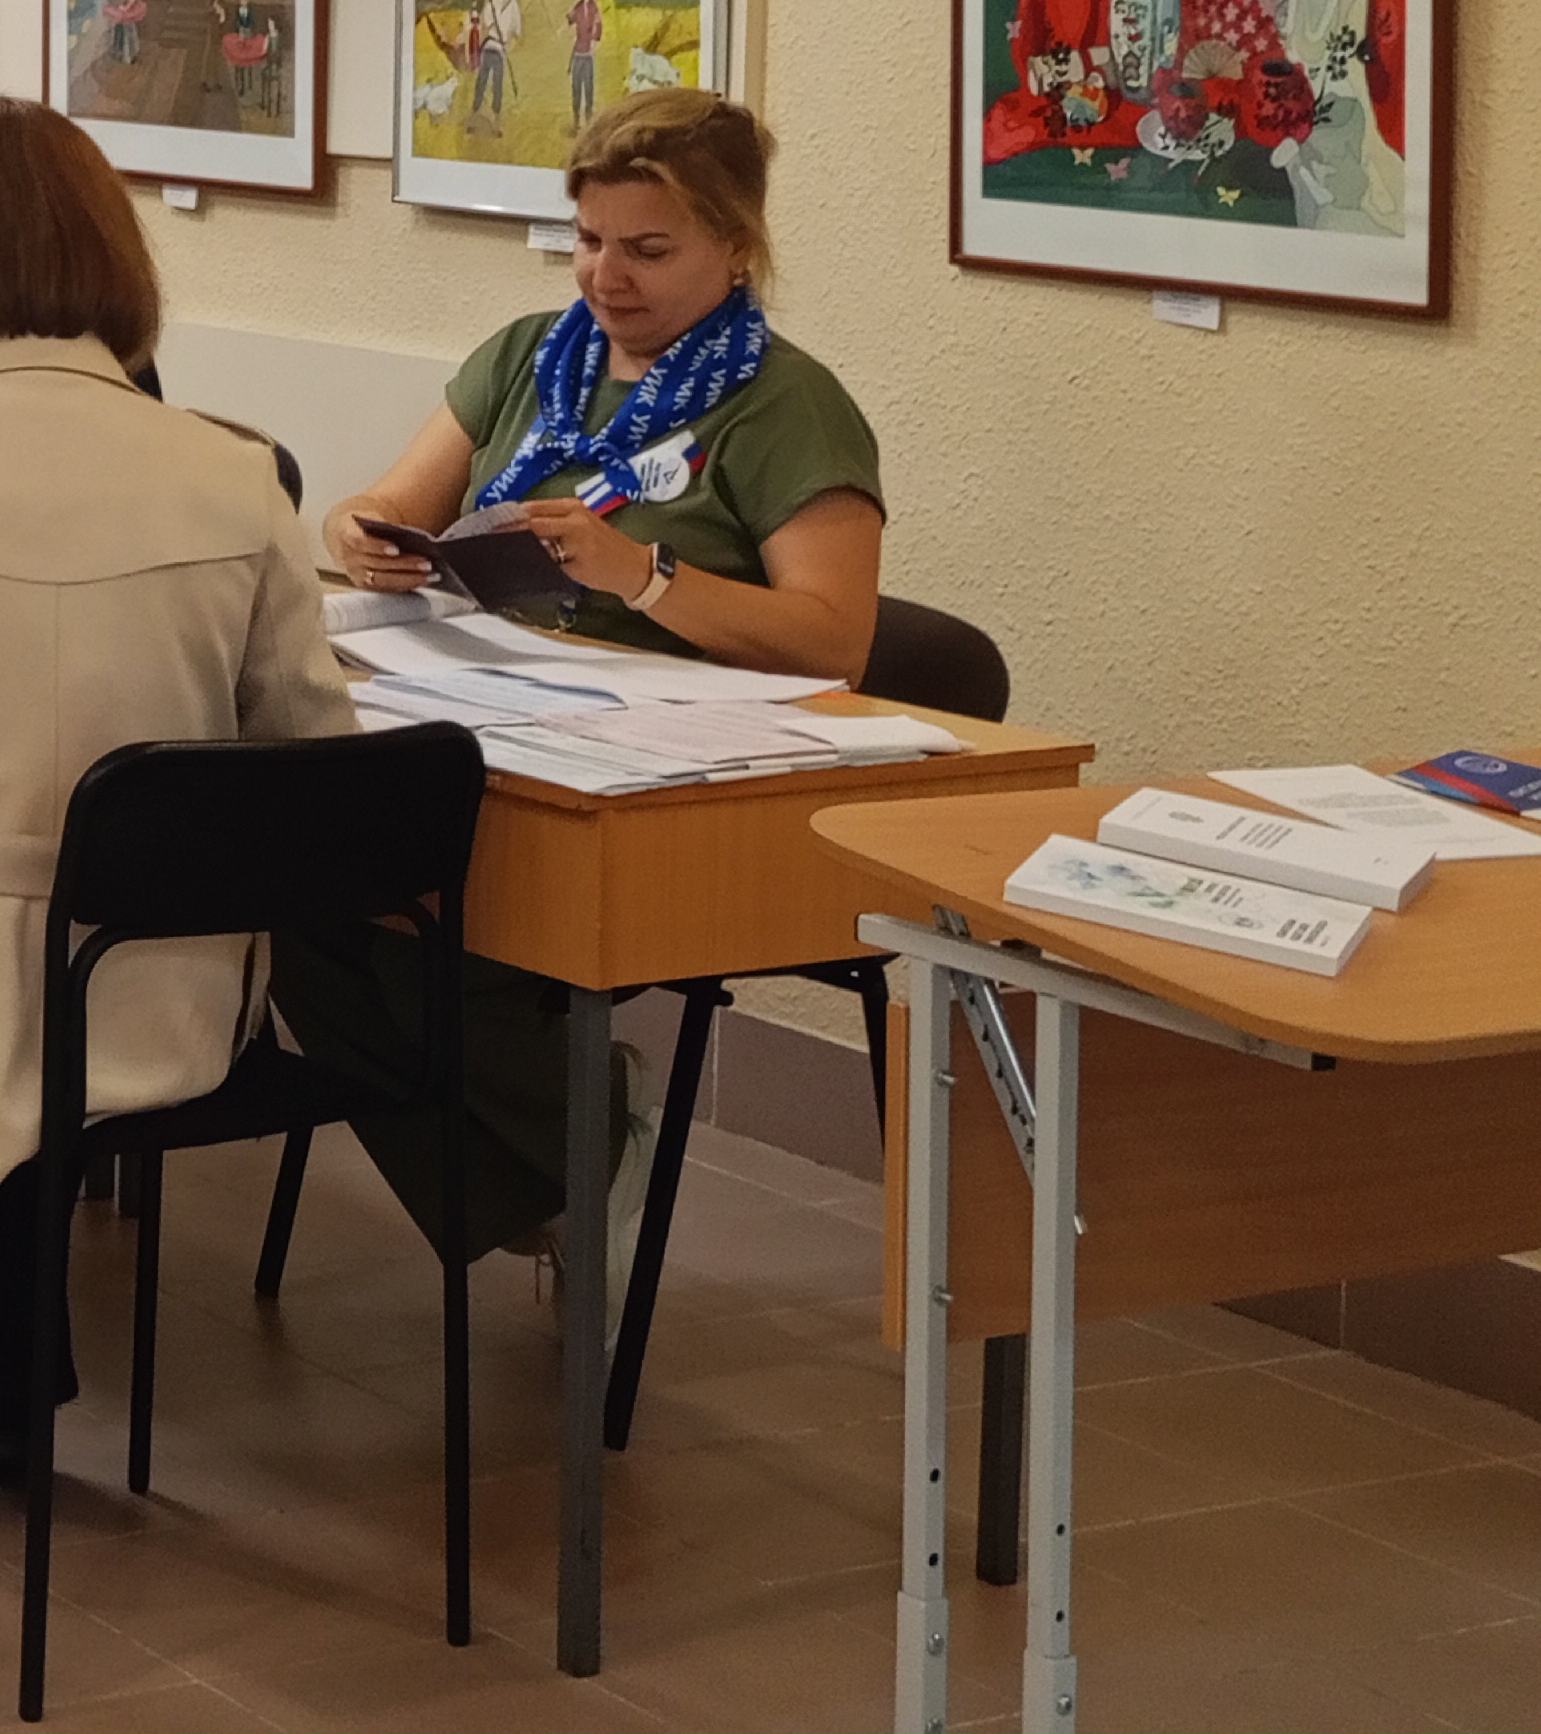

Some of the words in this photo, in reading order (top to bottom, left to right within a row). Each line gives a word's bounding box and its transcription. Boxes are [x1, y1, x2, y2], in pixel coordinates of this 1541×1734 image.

[635, 366, 668, 408] УИК
[627, 413, 652, 449] УИ
[486, 459, 524, 502] УИК
